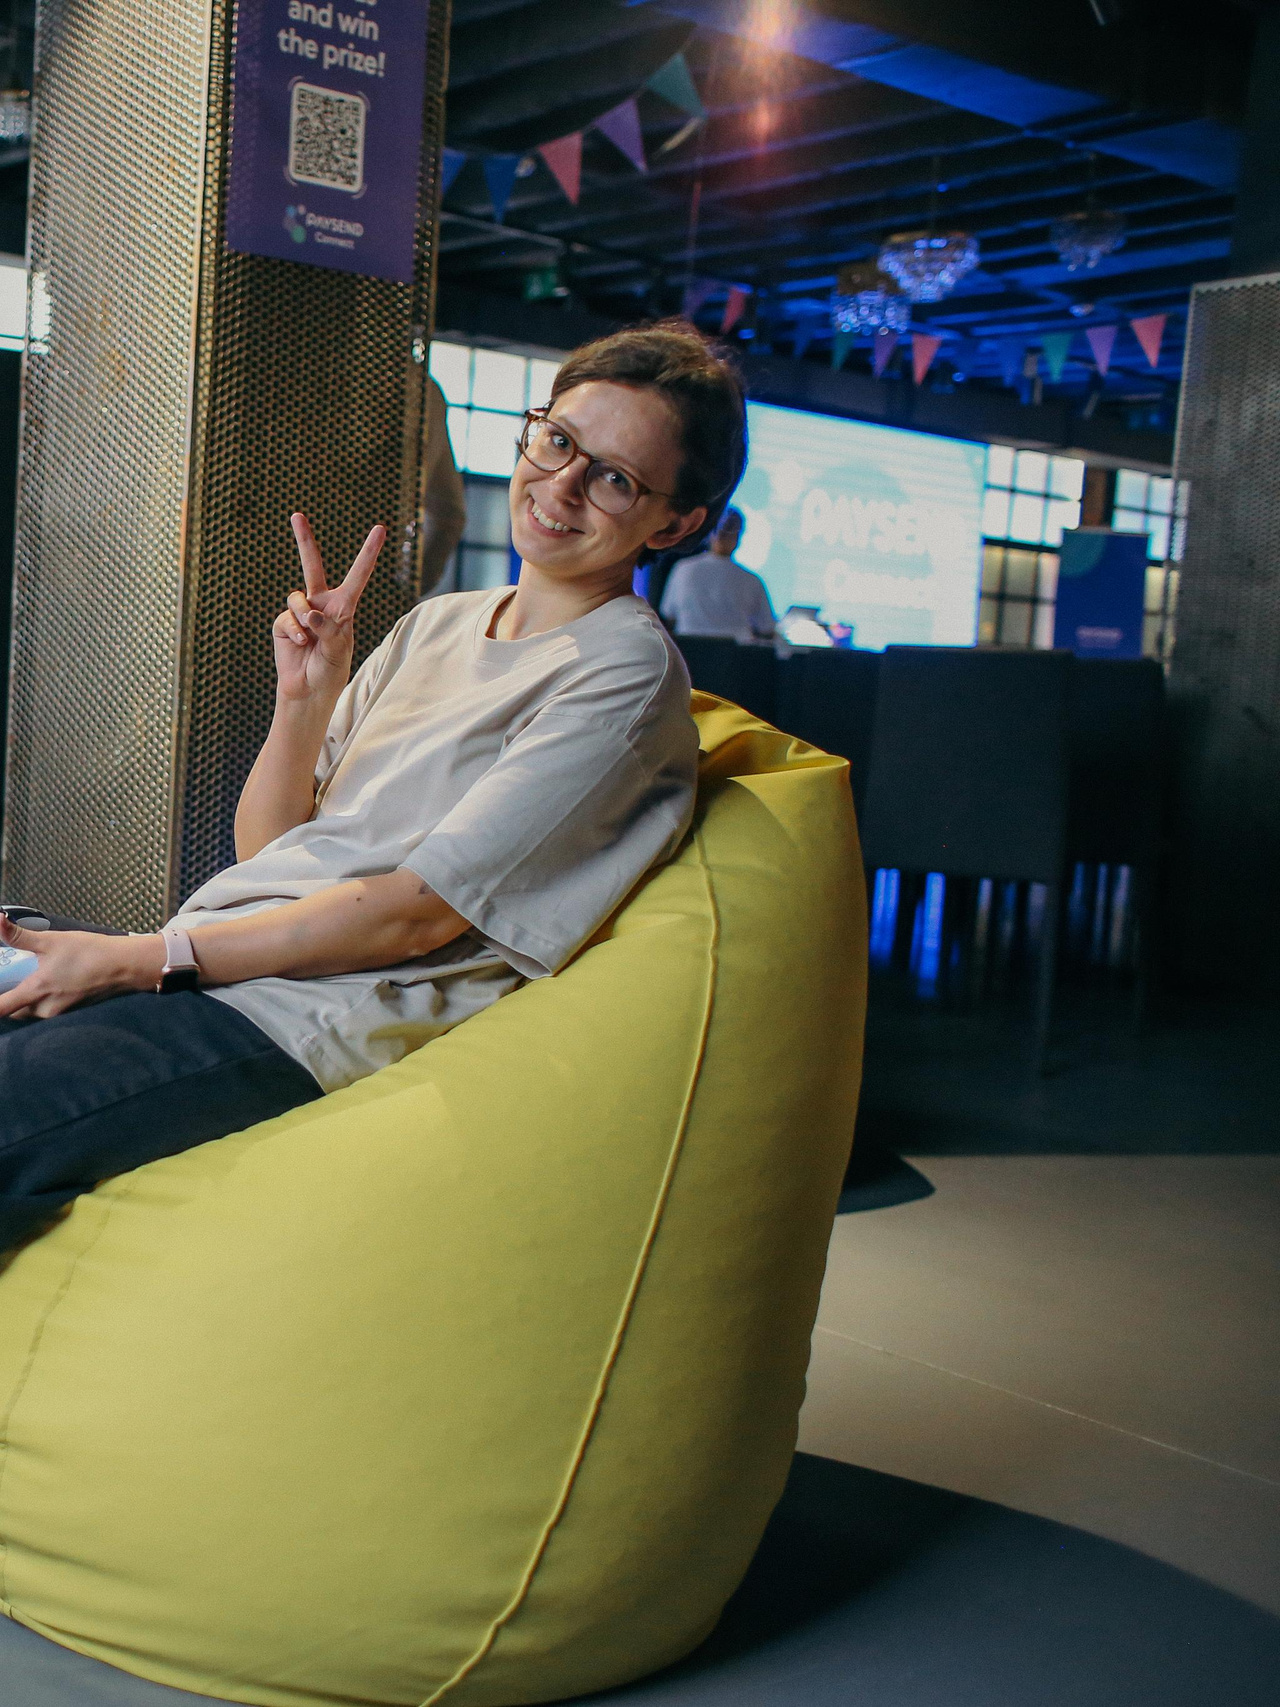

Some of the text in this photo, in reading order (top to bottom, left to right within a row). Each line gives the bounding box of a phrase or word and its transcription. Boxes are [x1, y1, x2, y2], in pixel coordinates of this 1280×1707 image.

[287, 0, 379, 41] and win
[277, 27, 386, 78] the prize!
